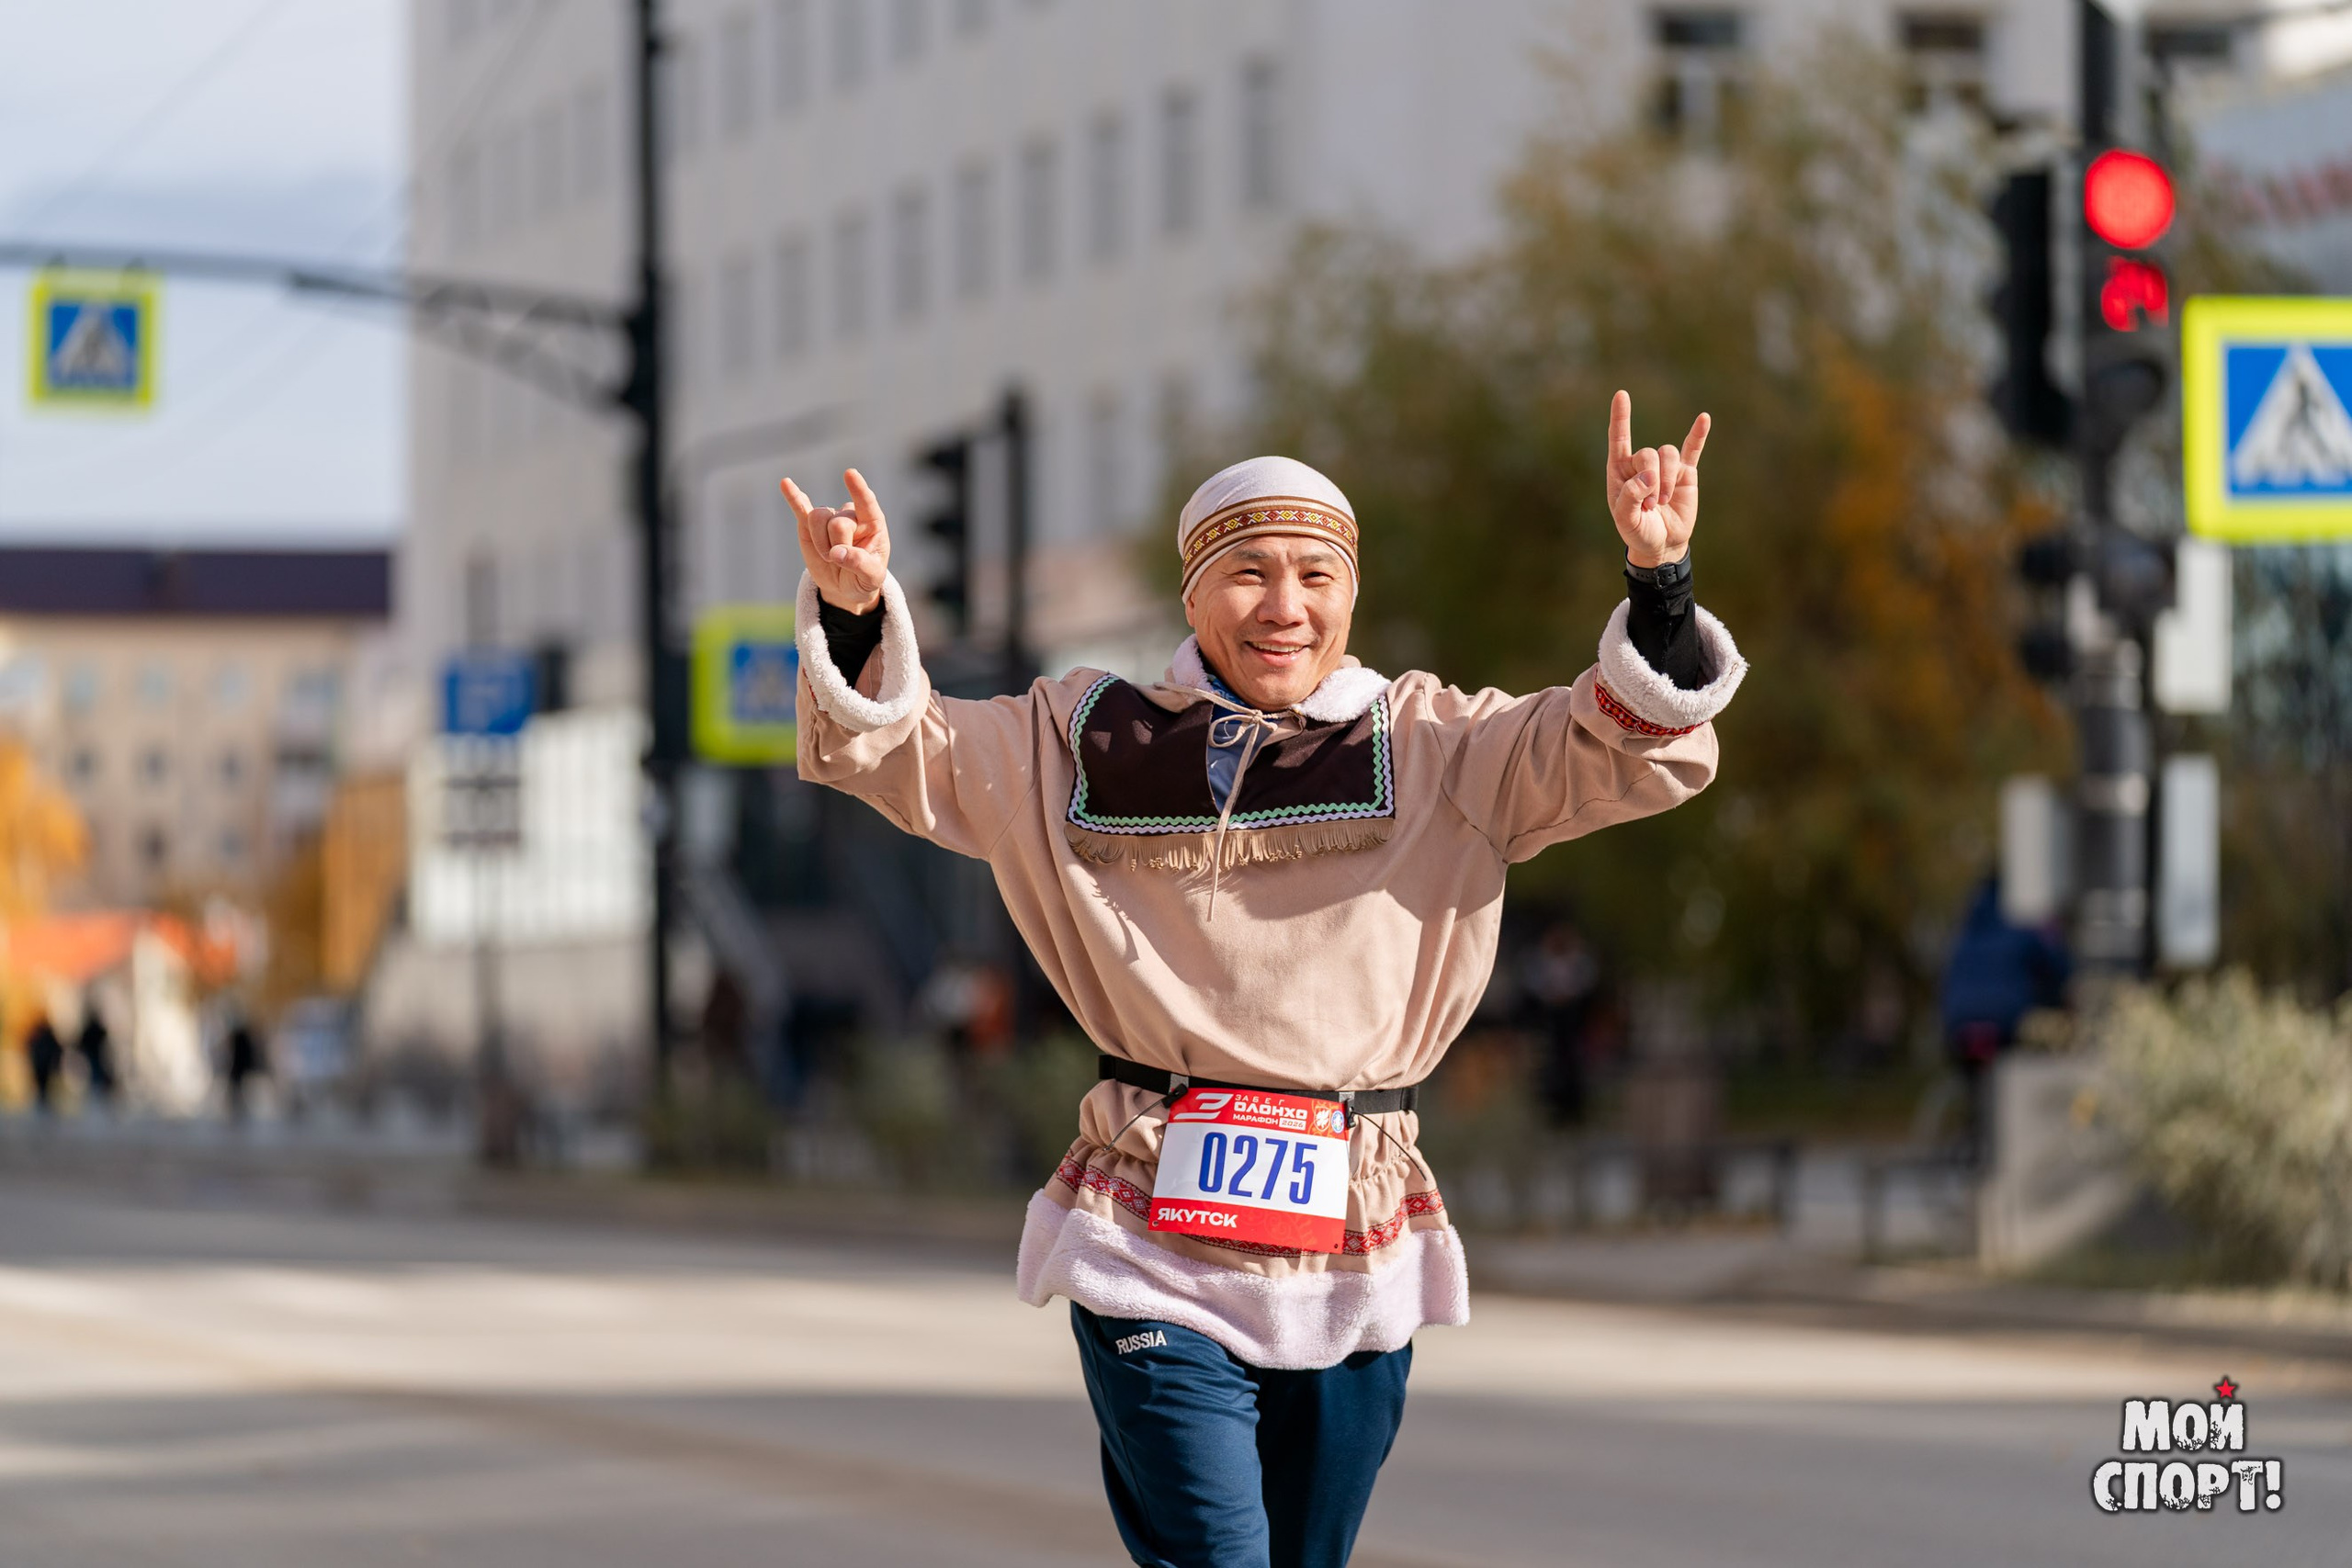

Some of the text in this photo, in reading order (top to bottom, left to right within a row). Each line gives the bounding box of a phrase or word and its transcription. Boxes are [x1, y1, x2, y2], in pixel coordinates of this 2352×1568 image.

[1233, 1113, 1278, 1125] МАРАФОН
[1234, 1101, 1308, 1120] ОЛОНХО
[1198, 1132, 1317, 1205] 0275
[1158, 1207, 1238, 1228] ЯКУТСК
[1115, 1329, 1168, 1355] RUSSIA
